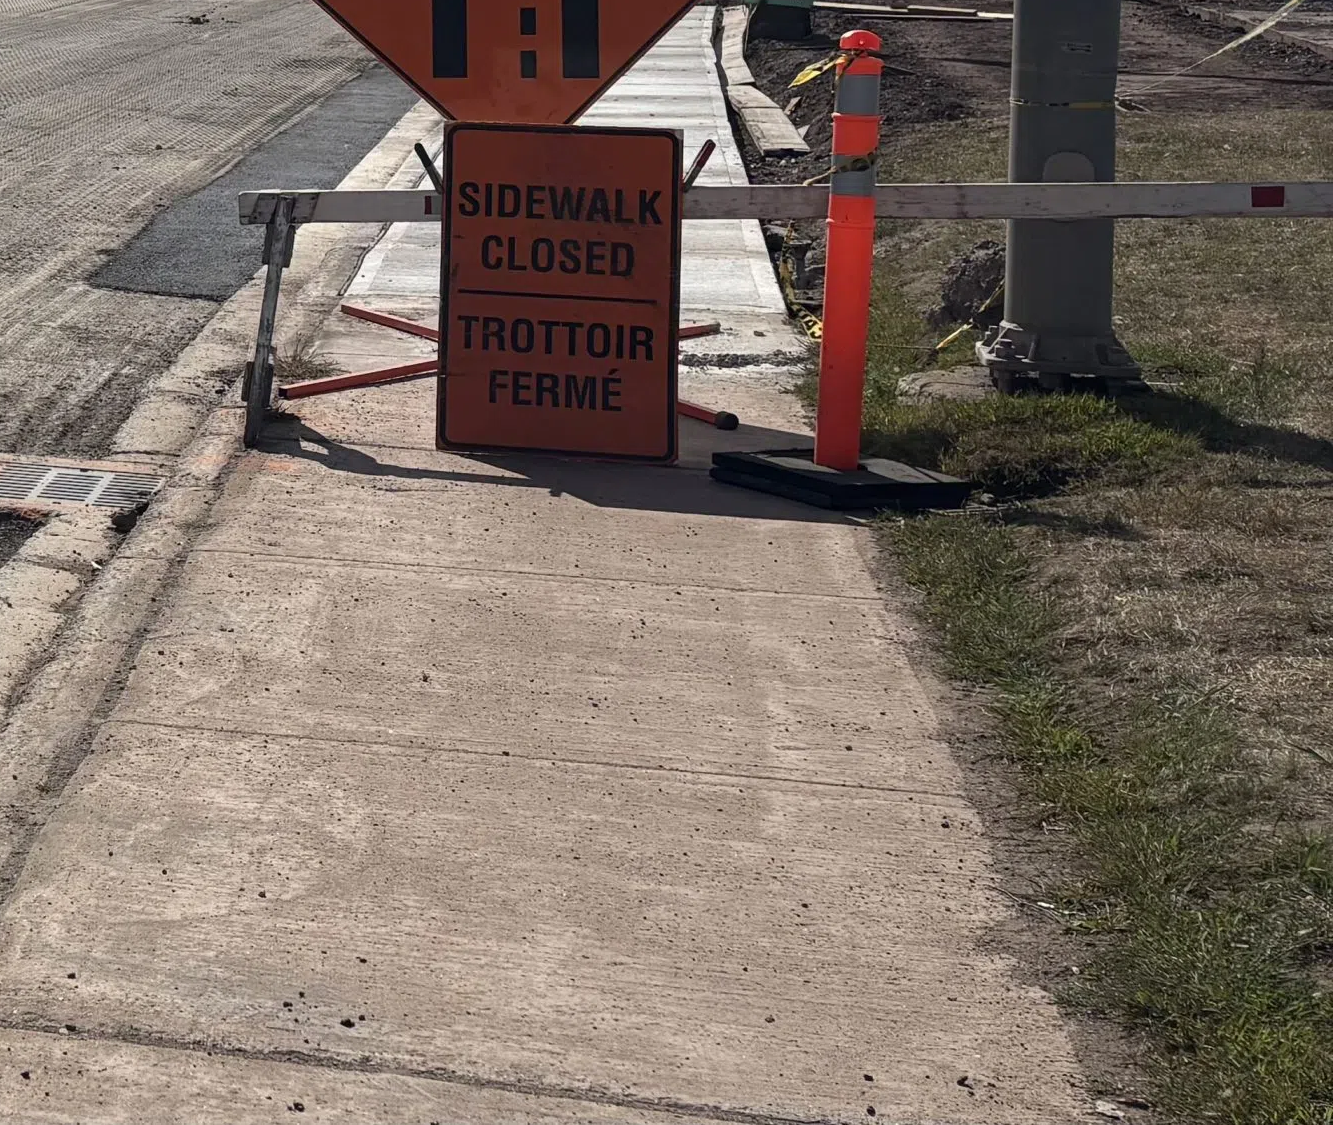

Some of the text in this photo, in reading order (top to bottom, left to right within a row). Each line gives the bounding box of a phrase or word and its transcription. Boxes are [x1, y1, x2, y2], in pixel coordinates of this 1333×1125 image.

[458, 181, 663, 225] SIDEWALK
[481, 235, 635, 276] CLOSED
[457, 315, 654, 361] TROTTOIR
[489, 368, 622, 411] FERMÉ
